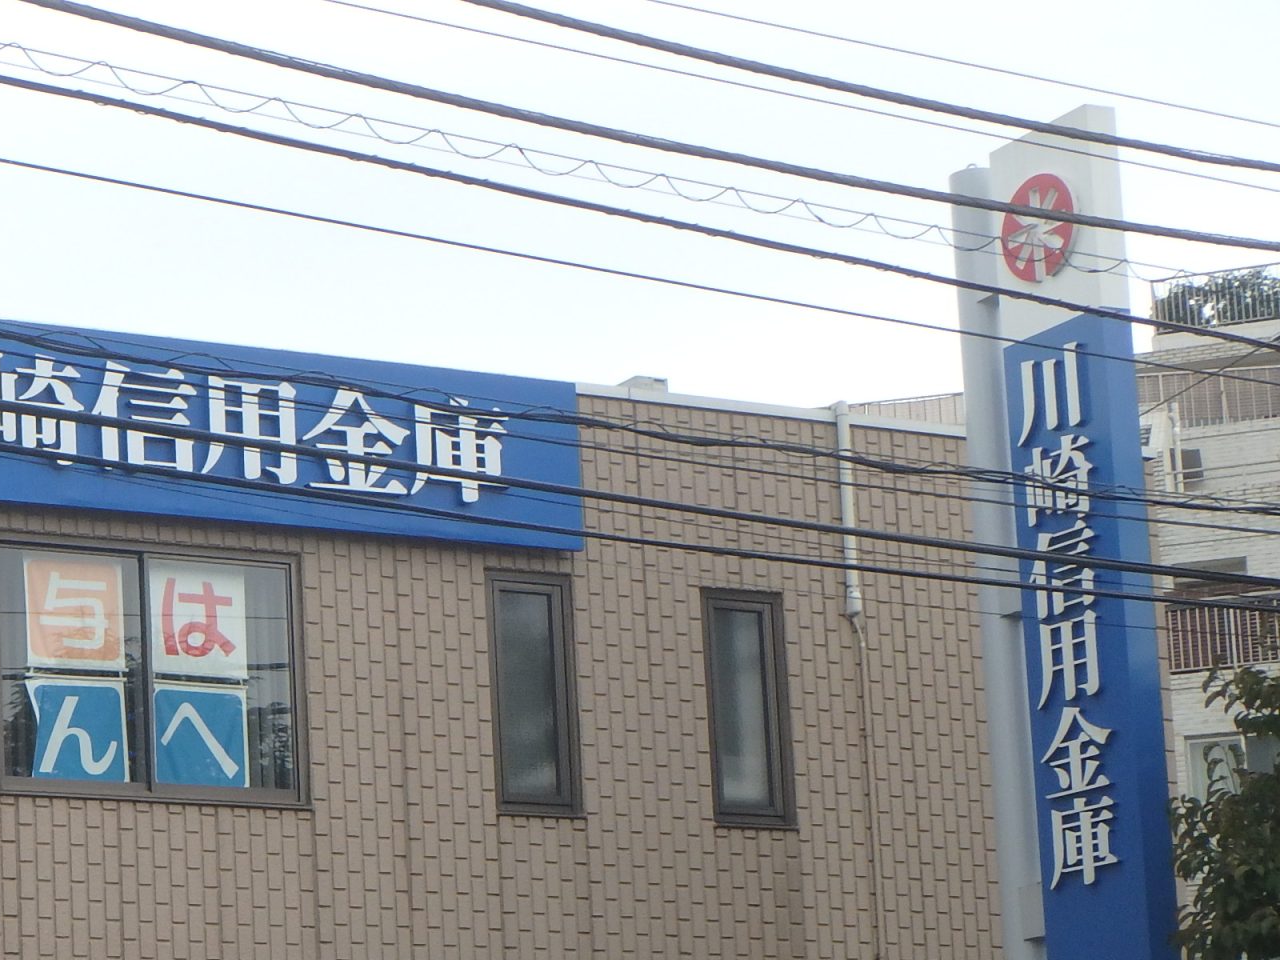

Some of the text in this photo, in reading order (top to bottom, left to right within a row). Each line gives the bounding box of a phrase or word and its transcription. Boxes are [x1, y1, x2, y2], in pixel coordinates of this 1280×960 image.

[1017, 341, 1120, 891] 川崎信用金庫
